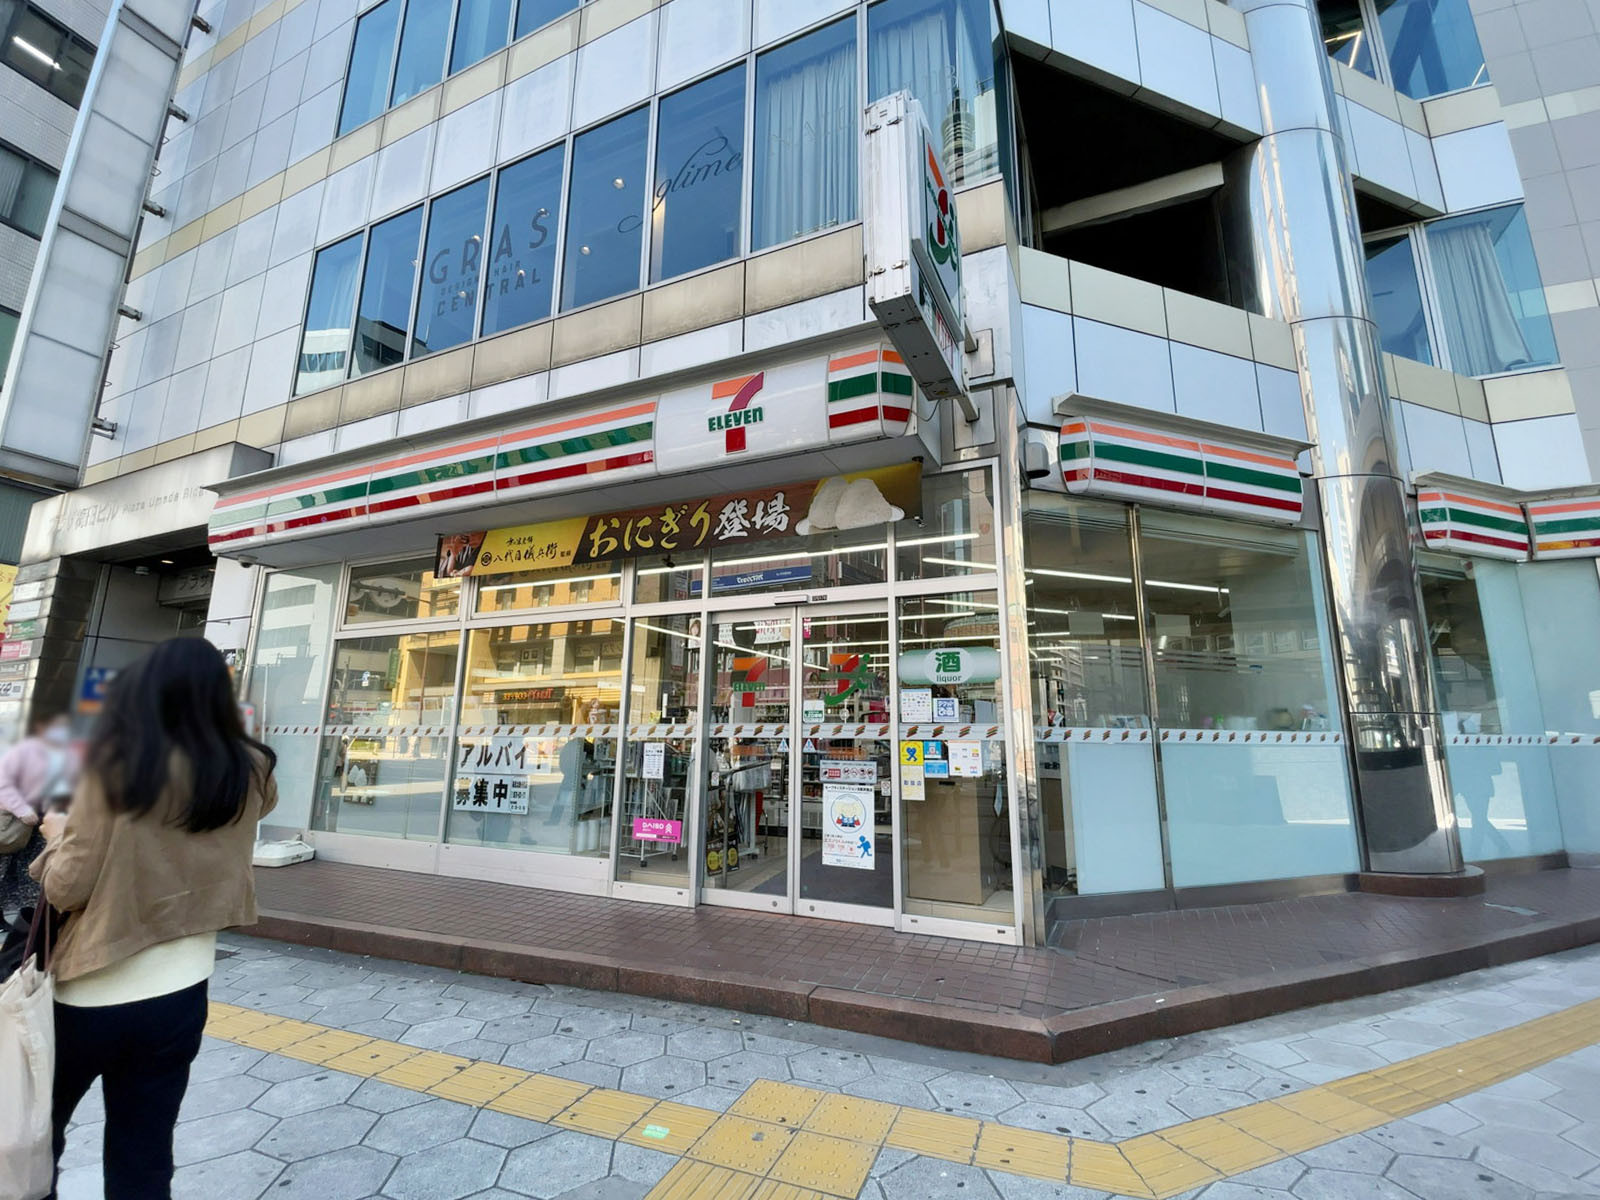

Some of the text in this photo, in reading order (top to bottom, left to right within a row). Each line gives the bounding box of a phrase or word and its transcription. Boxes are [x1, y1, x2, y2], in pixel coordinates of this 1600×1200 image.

[429, 208, 549, 285] GRAS
[437, 267, 541, 316] CENTRAL
[590, 491, 792, 558] おにぎり登場
[935, 651, 961, 673] 酒
[936, 675, 962, 683] liquor
[461, 741, 541, 770] アルバイ
[456, 777, 509, 808] 募集中
